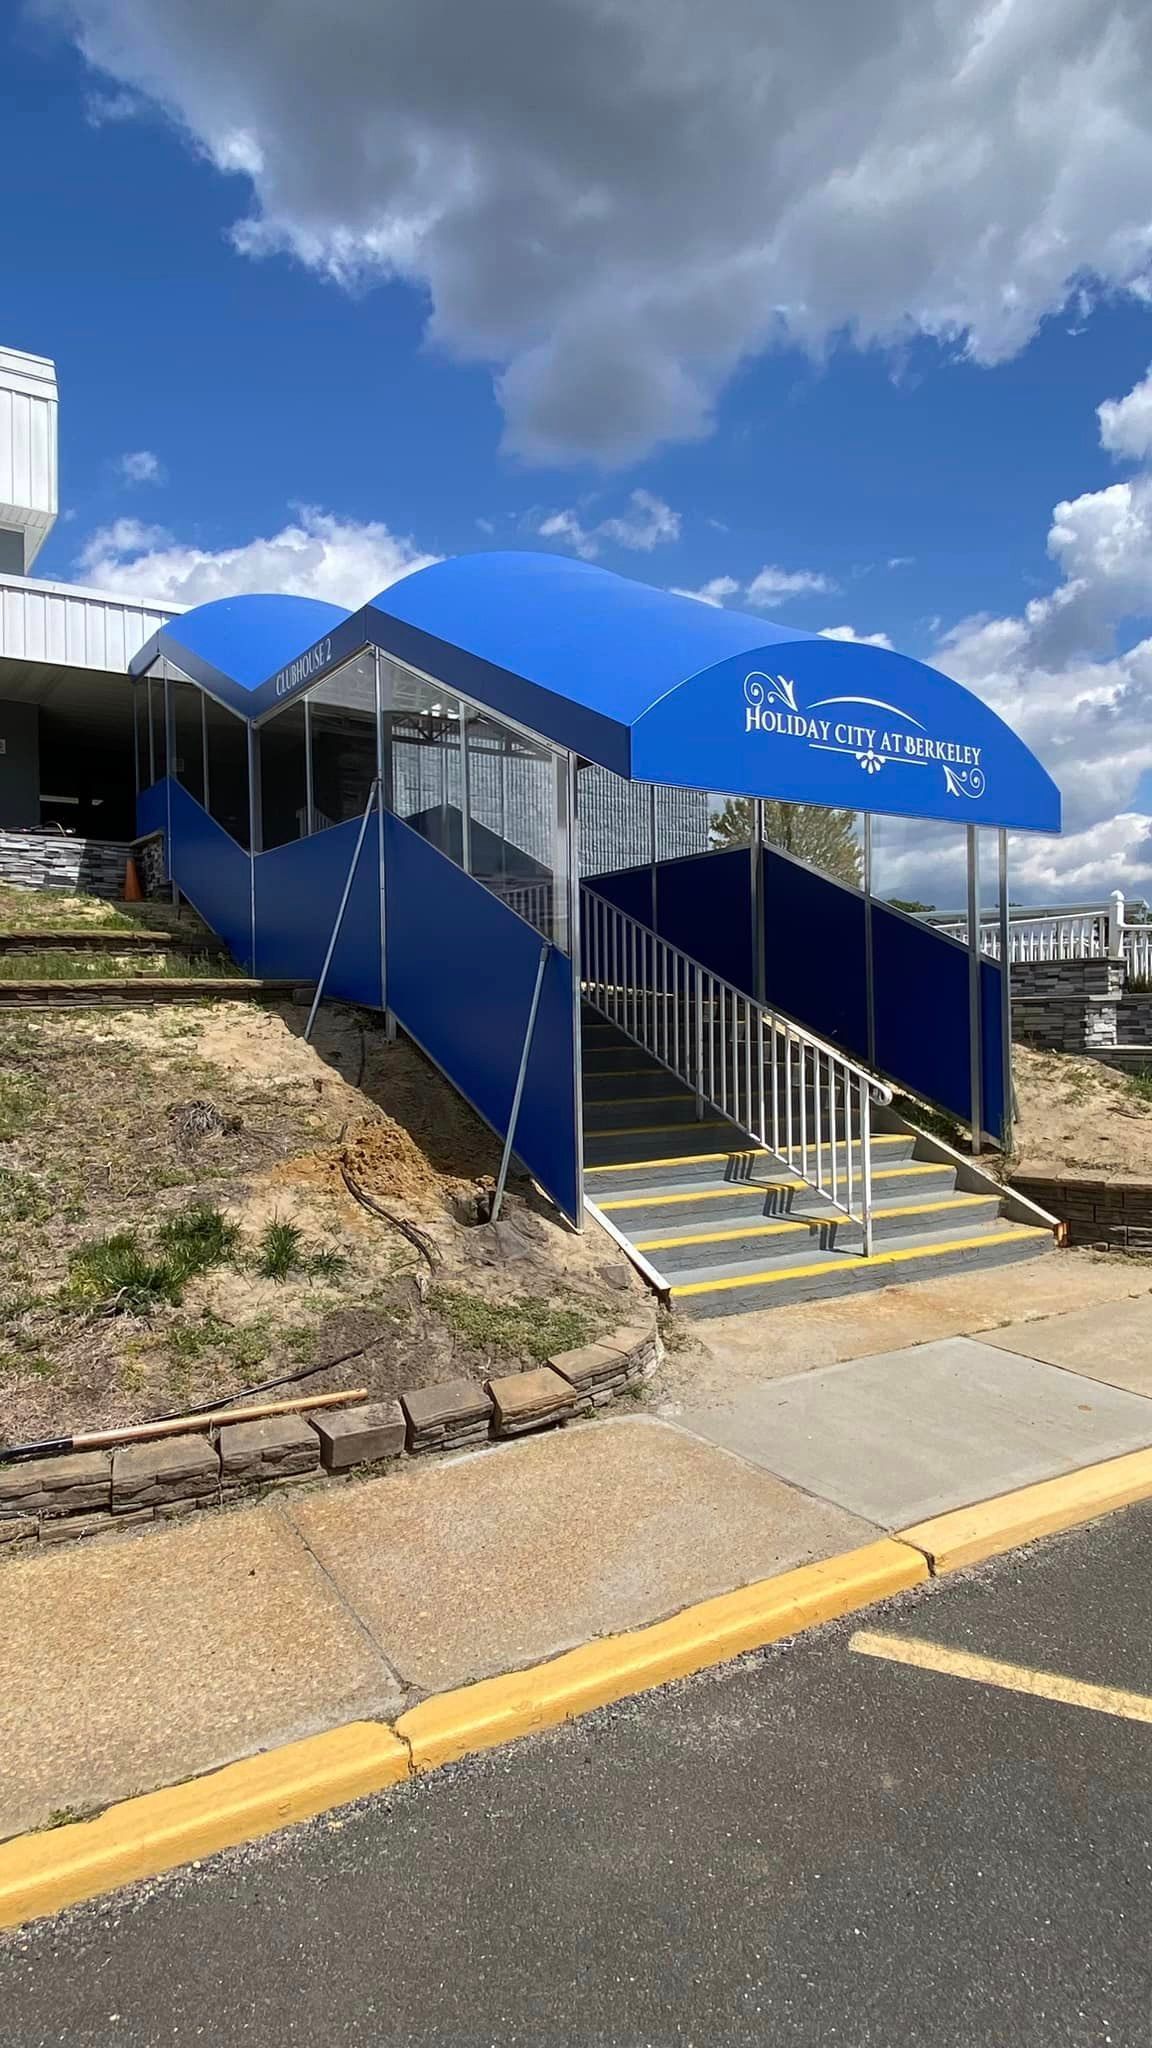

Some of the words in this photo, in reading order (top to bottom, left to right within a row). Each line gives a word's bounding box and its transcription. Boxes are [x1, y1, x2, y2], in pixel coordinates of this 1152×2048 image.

[276, 643, 324, 696] CLUBHOUSE
[325, 638, 332, 662] 2
[745, 706, 831, 741] HOLIDAY
[834, 723, 876, 749] CITY
[880, 732, 903, 753] AT
[904, 735, 981, 765] BERKELEY
